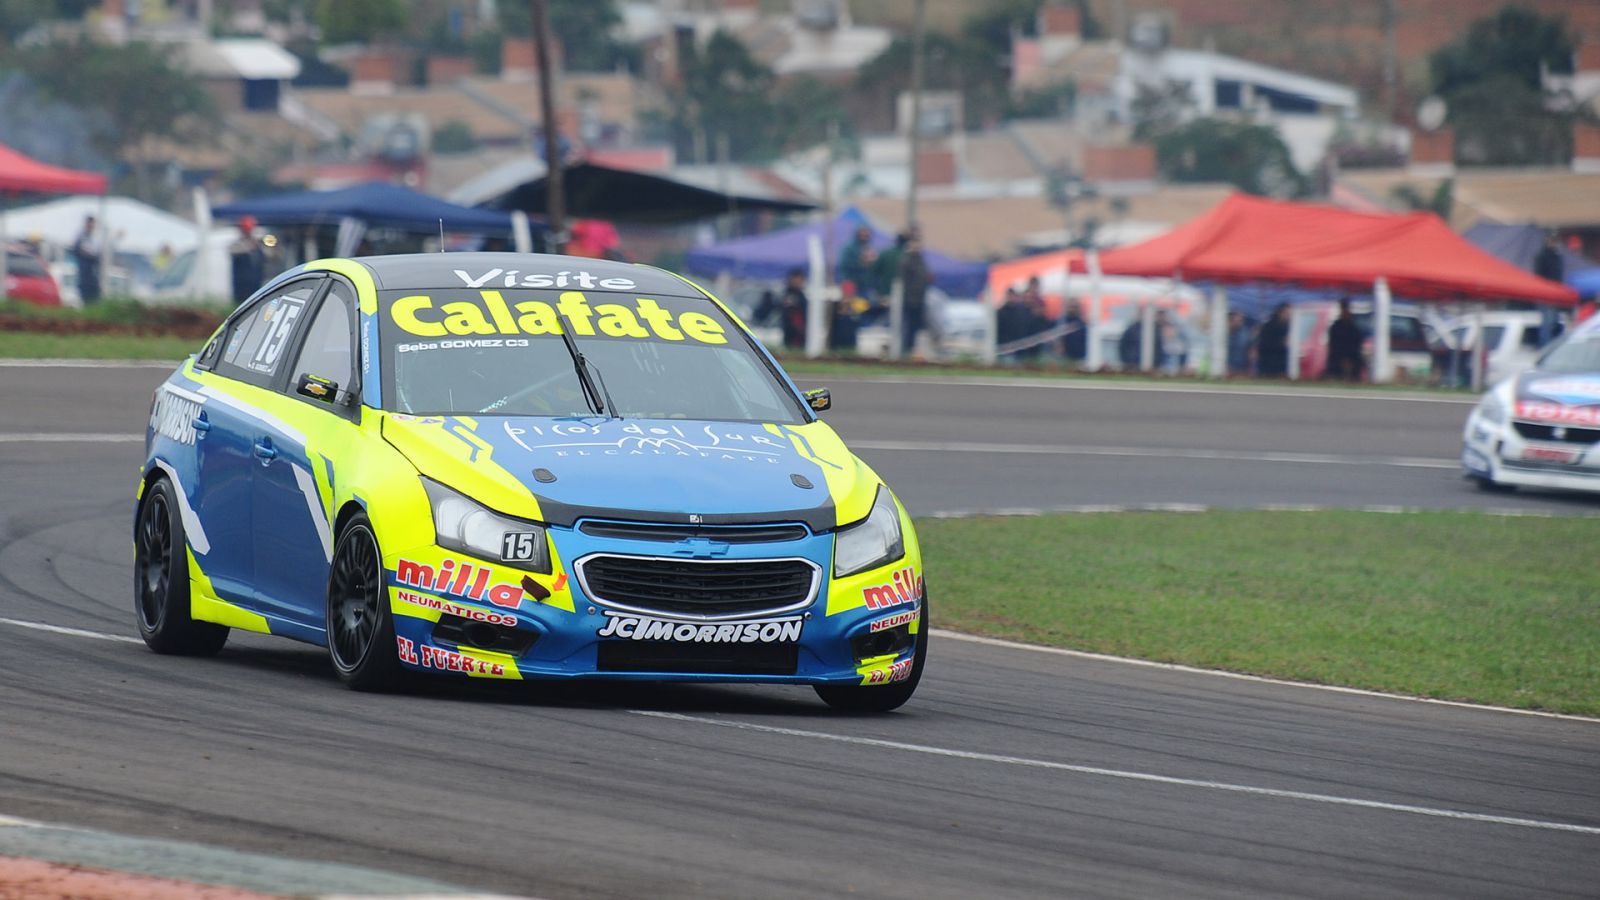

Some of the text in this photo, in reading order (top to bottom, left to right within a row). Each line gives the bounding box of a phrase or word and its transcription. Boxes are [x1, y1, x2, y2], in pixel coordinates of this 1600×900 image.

[454, 268, 637, 290] Visite
[255, 304, 300, 364] 15
[390, 290, 729, 345] Calafate
[398, 339, 529, 353] Seba GOMEZ C3
[604, 449, 780, 464] CALAFATE
[505, 533, 533, 559] 15
[395, 559, 525, 610] milla
[397, 590, 518, 627] NEUMATICOS
[396, 635, 505, 677] EL FUERTE
